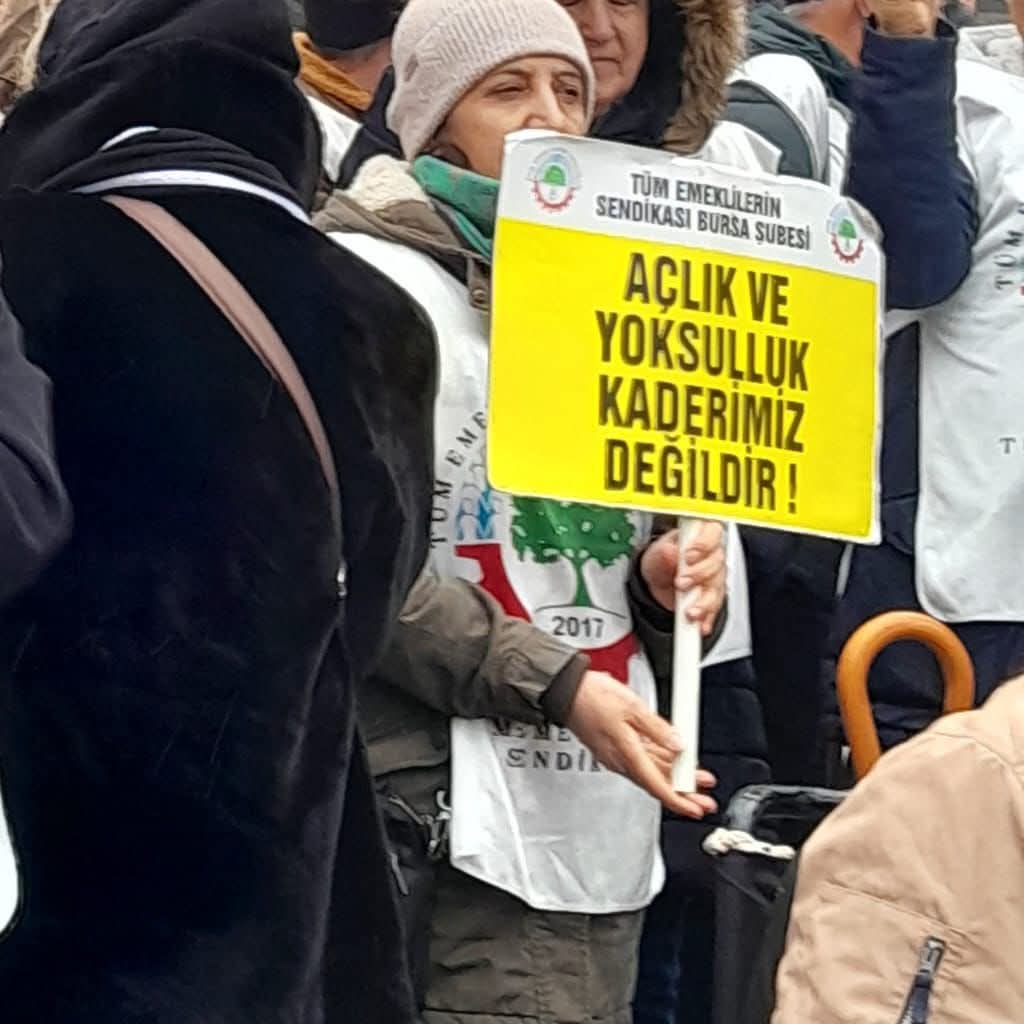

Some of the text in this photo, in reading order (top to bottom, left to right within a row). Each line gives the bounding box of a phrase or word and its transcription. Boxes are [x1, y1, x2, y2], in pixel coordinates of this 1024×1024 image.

[596, 194, 811, 251] SENDİKASI BURSA ŞUBESİ
[630, 170, 781, 219] TÜM EMEKLİLERİN
[623, 252, 790, 327] AÇLIK VE
[594, 310, 810, 392] YOKSULLUK
[597, 373, 805, 453] KADERİMİZ
[604, 435, 777, 511] DEĞİLDİR
[552, 616, 604, 638] 2017
